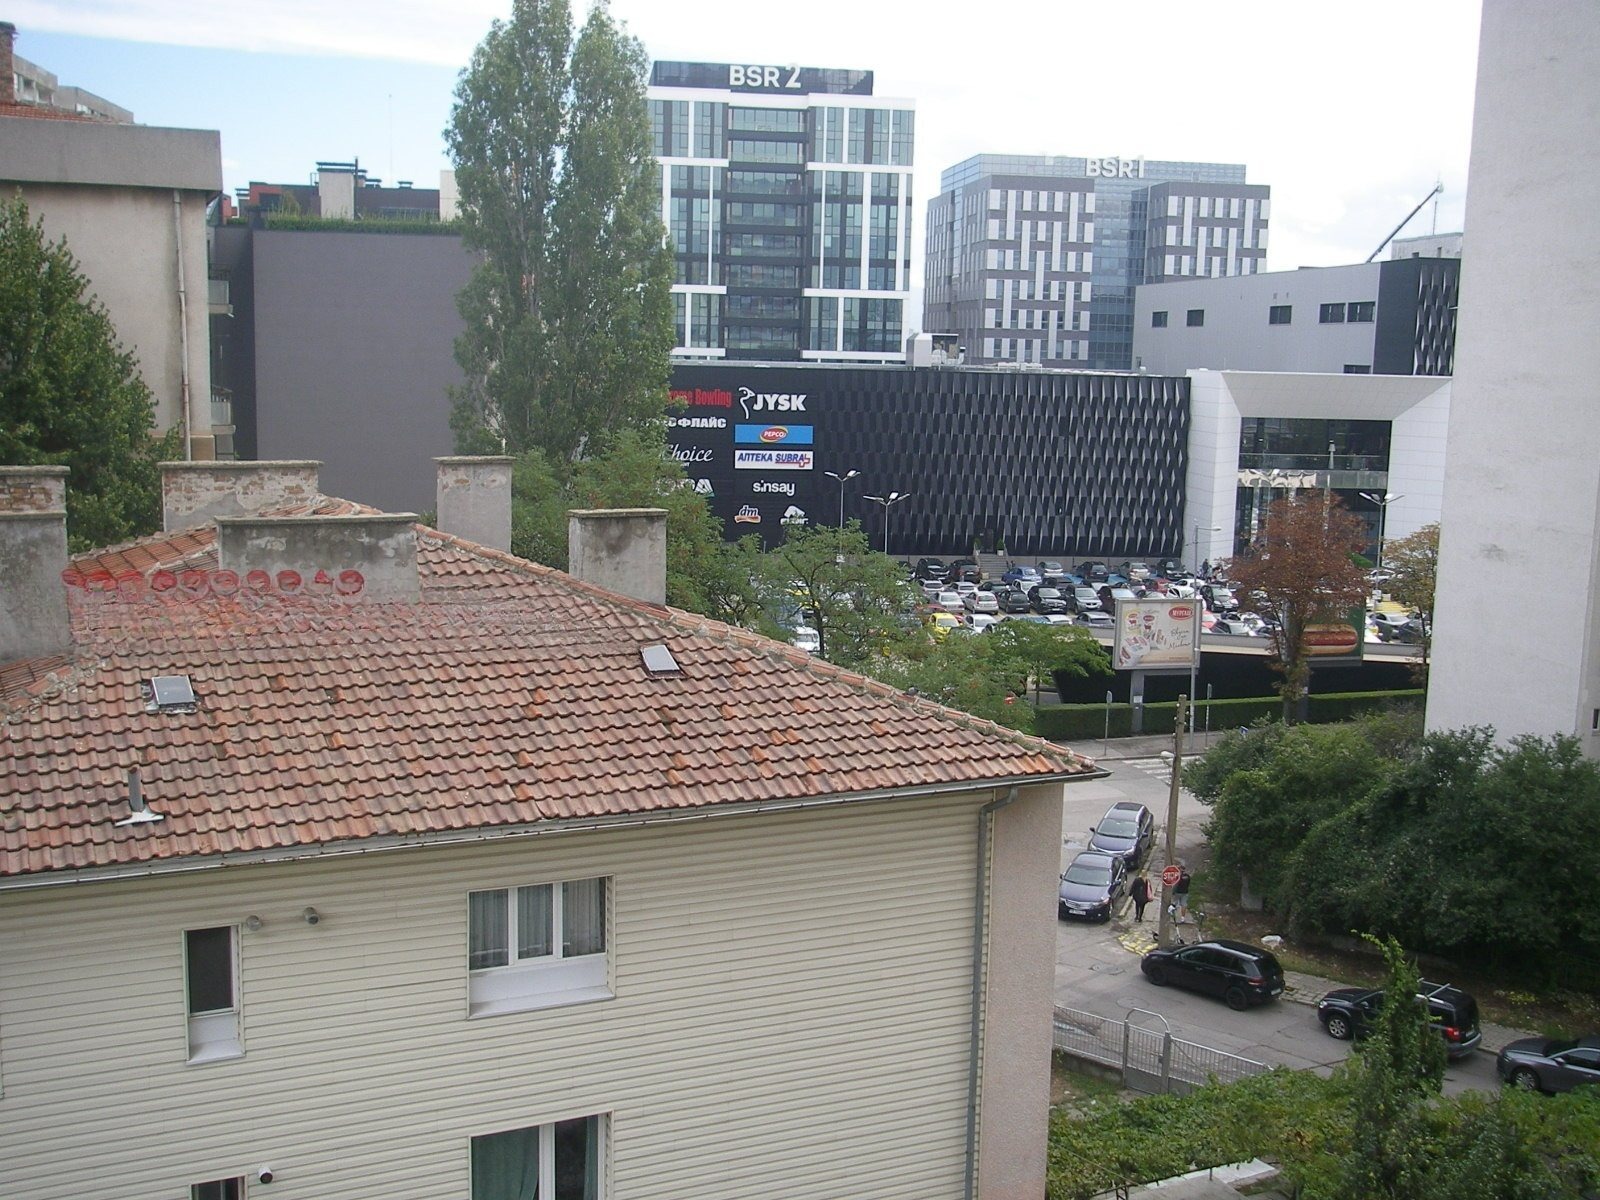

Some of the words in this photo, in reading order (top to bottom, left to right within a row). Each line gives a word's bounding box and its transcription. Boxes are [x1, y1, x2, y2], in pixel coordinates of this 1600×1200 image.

[729, 65, 780, 88] BSR
[785, 63, 801, 88] 2
[1086, 157, 1133, 178] BSR
[695, 388, 732, 407] Bowling
[753, 394, 807, 411] JYSK
[738, 452, 773, 462] АПТЕКА
[775, 453, 805, 462] SUBRA
[753, 480, 795, 496] sinsay
[739, 505, 759, 517] dm
[1163, 871, 1179, 880] STOP
